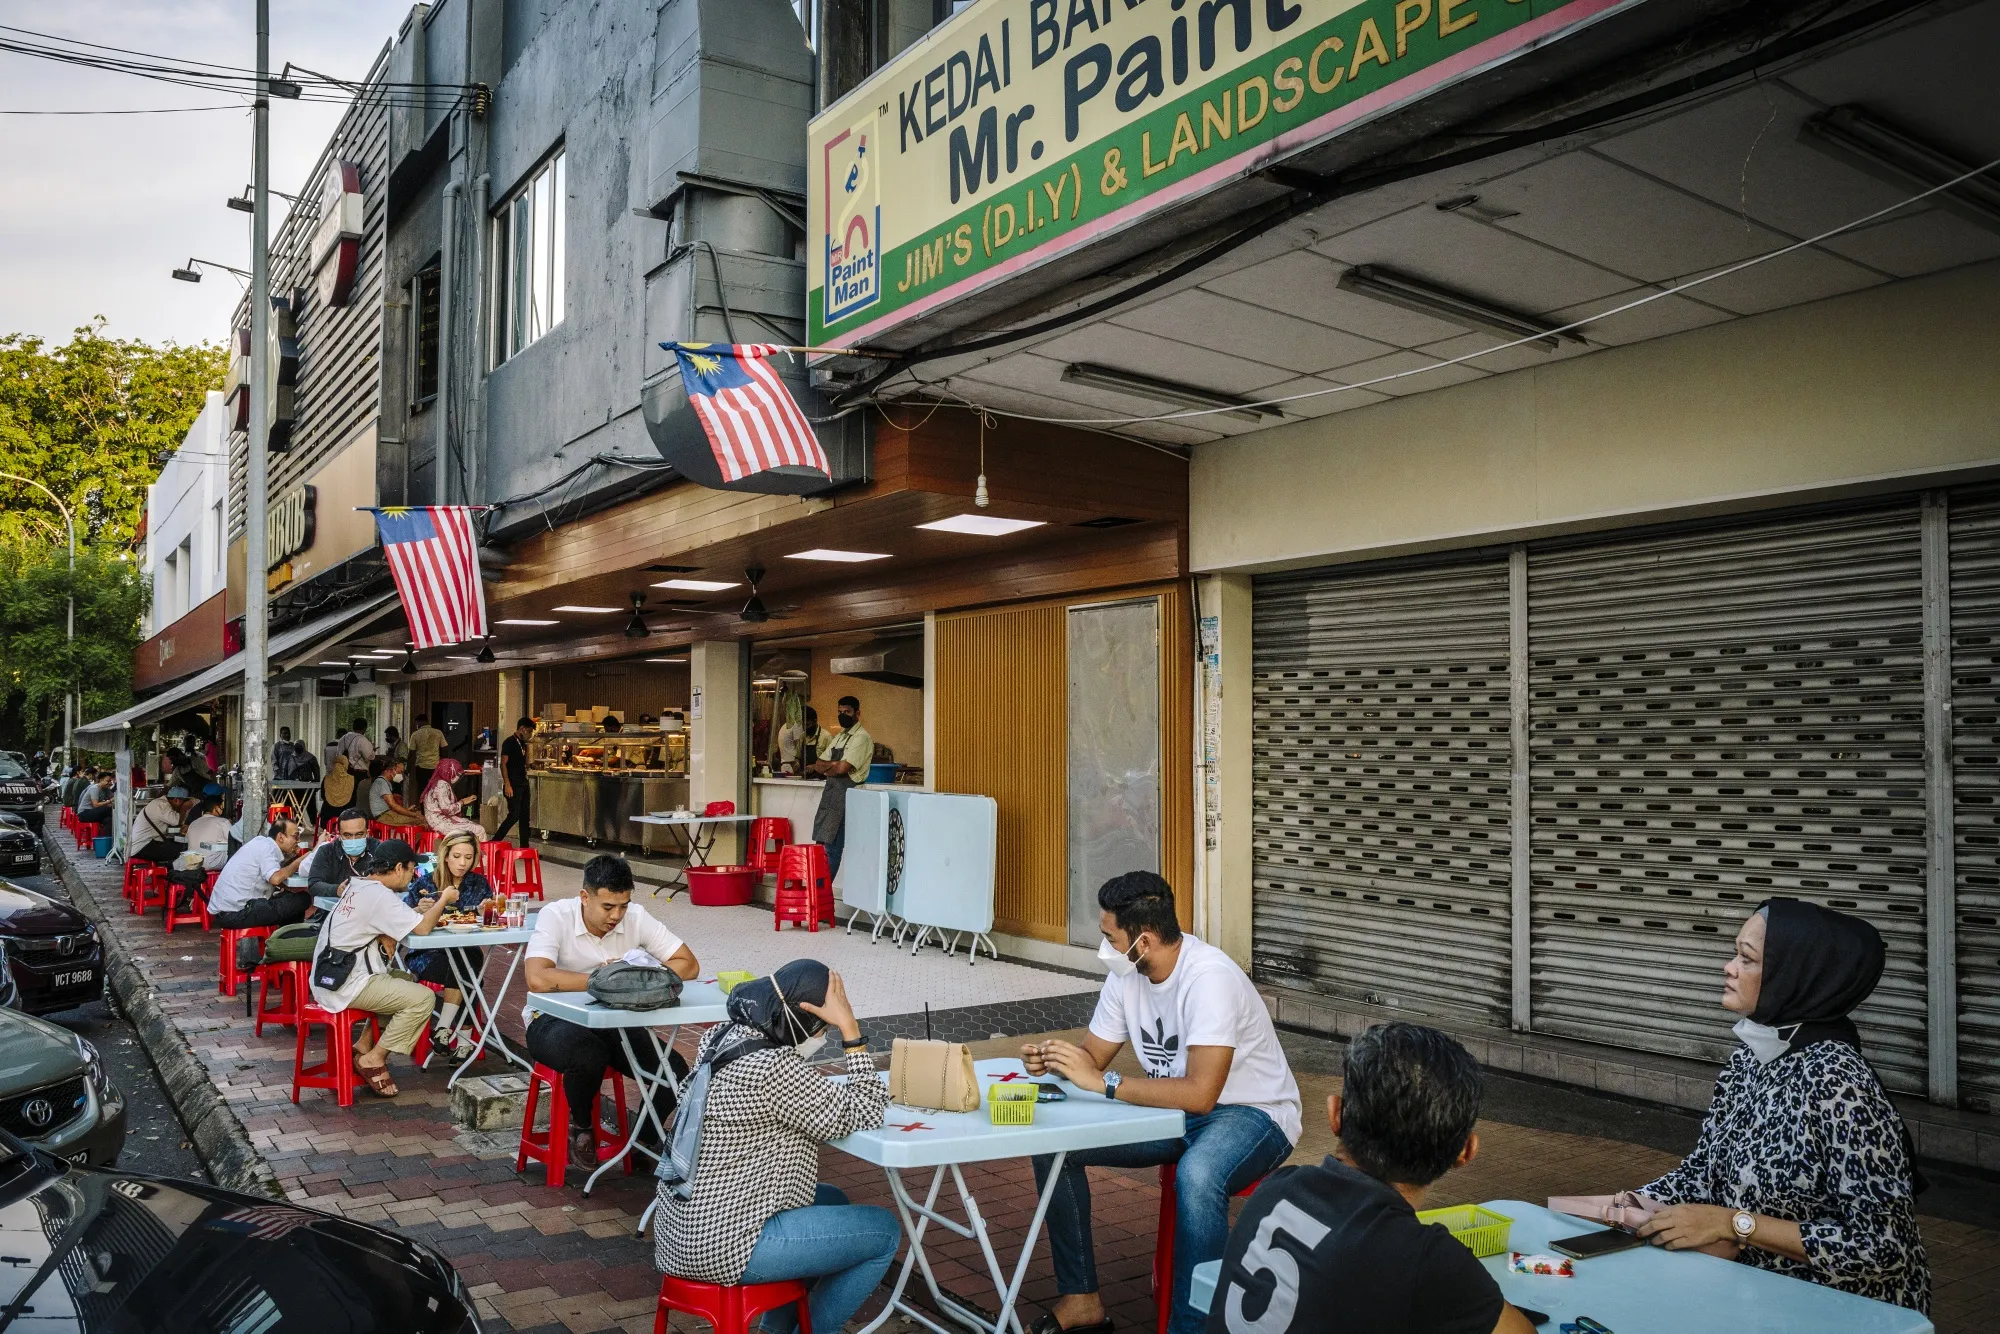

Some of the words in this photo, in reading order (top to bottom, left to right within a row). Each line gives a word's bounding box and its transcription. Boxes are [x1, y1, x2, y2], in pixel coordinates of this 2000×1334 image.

[878, 101, 889, 118] TM
[900, 18, 1011, 154] KEDAI
[897, 224, 972, 293] JIM'S
[982, 162, 1082, 258] (D.I.Y)
[1100, 147, 1128, 196] &
[1142, 0, 1478, 179] LANDSCAPE
[949, 104, 1044, 205] Mr.
[831, 248, 874, 286] Paint
[834, 275, 870, 307] Man
[268, 484, 306, 570] HBUB
[55, 972, 71, 987] VCT
[71, 969, 92, 984] 9688
[1225, 1199, 1332, 1334] 5
